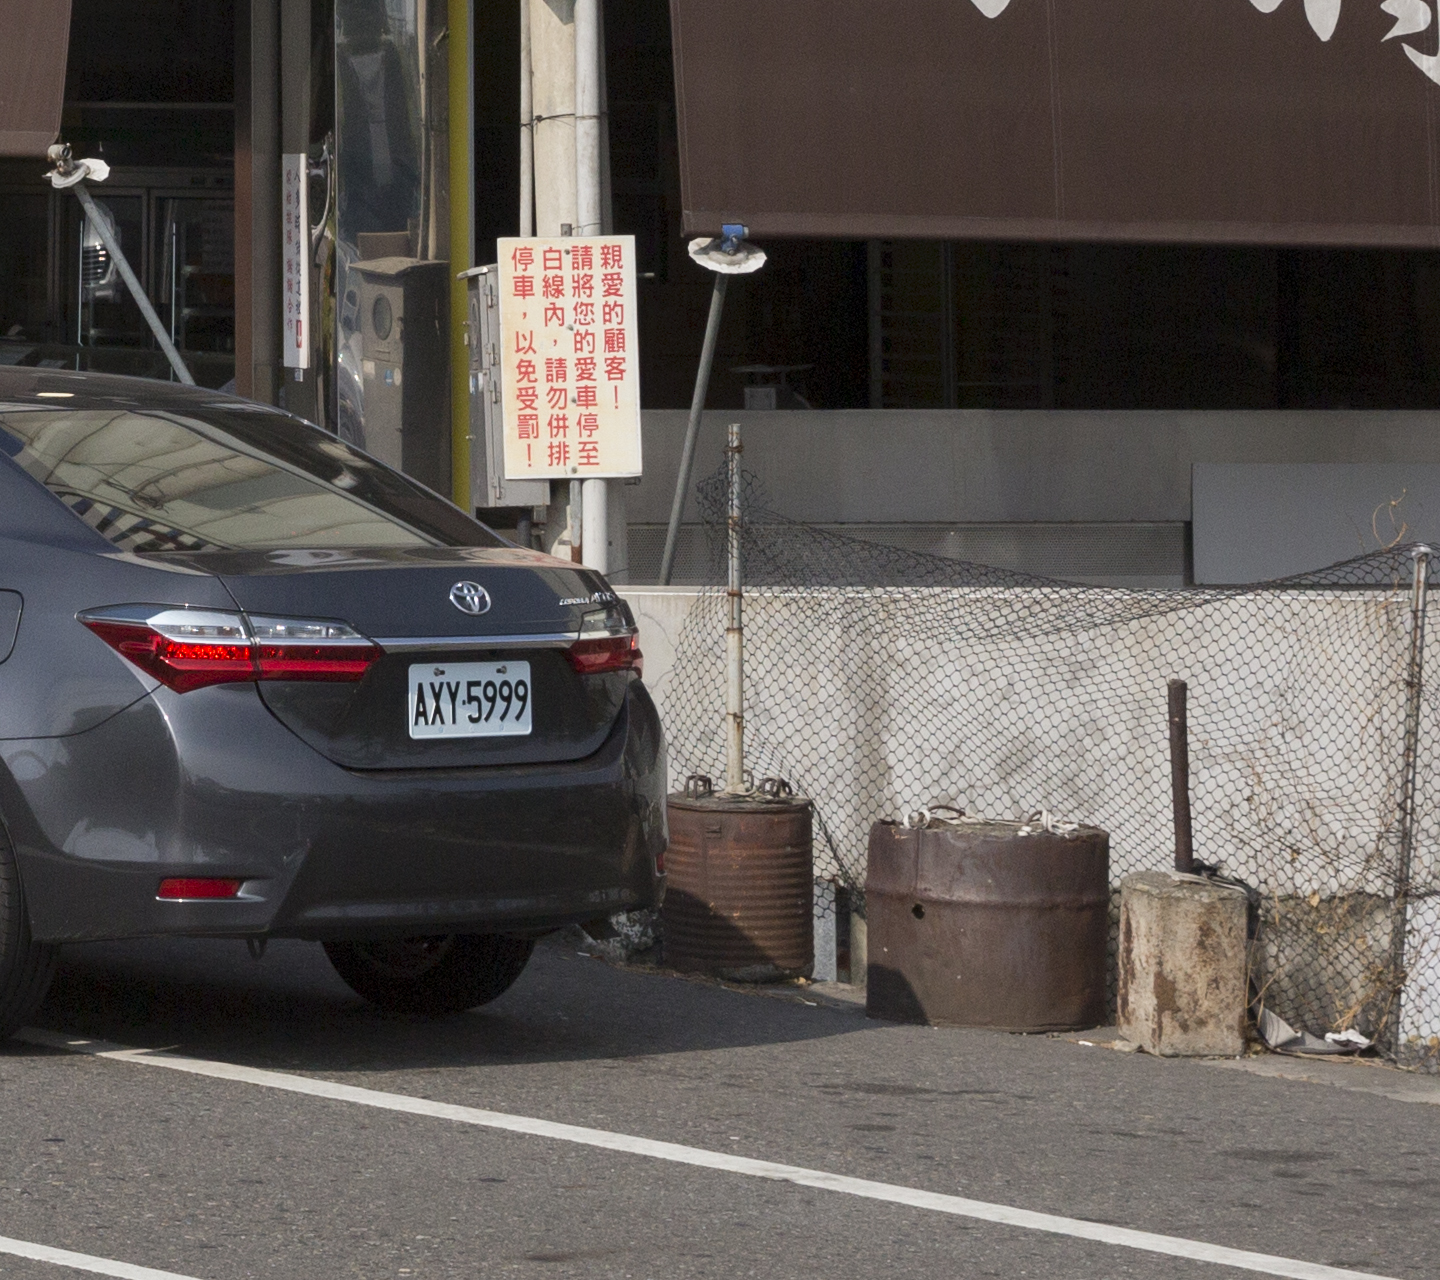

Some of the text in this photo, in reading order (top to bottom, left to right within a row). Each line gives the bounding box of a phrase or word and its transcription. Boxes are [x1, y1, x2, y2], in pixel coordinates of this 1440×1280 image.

[570, 245, 600, 467] 請將您的愛車停至
